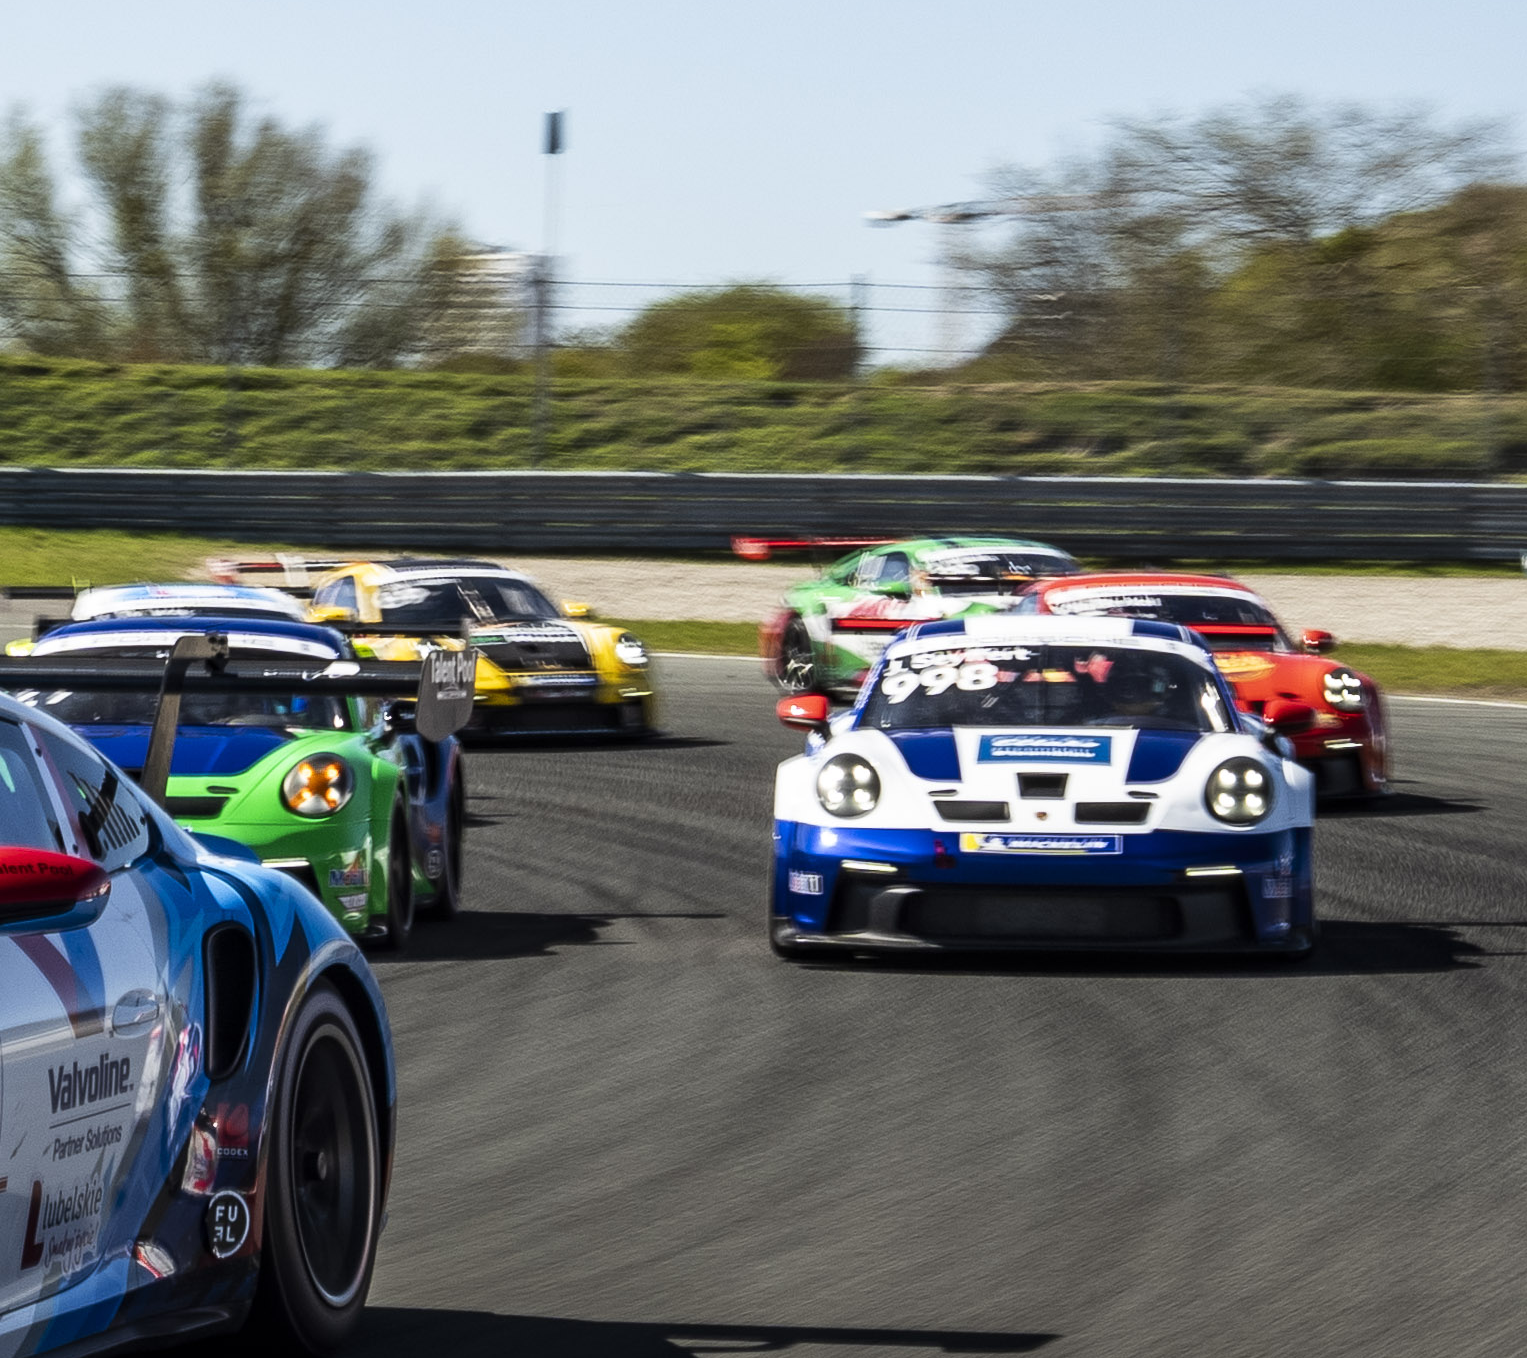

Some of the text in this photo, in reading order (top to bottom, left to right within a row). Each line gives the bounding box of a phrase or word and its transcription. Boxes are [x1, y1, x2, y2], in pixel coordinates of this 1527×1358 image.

[881, 663, 999, 704] 998
[37, 862, 74, 876] Pool
[48, 1053, 131, 1114] Valvoline
[53, 1125, 123, 1162] Partner Solutions
